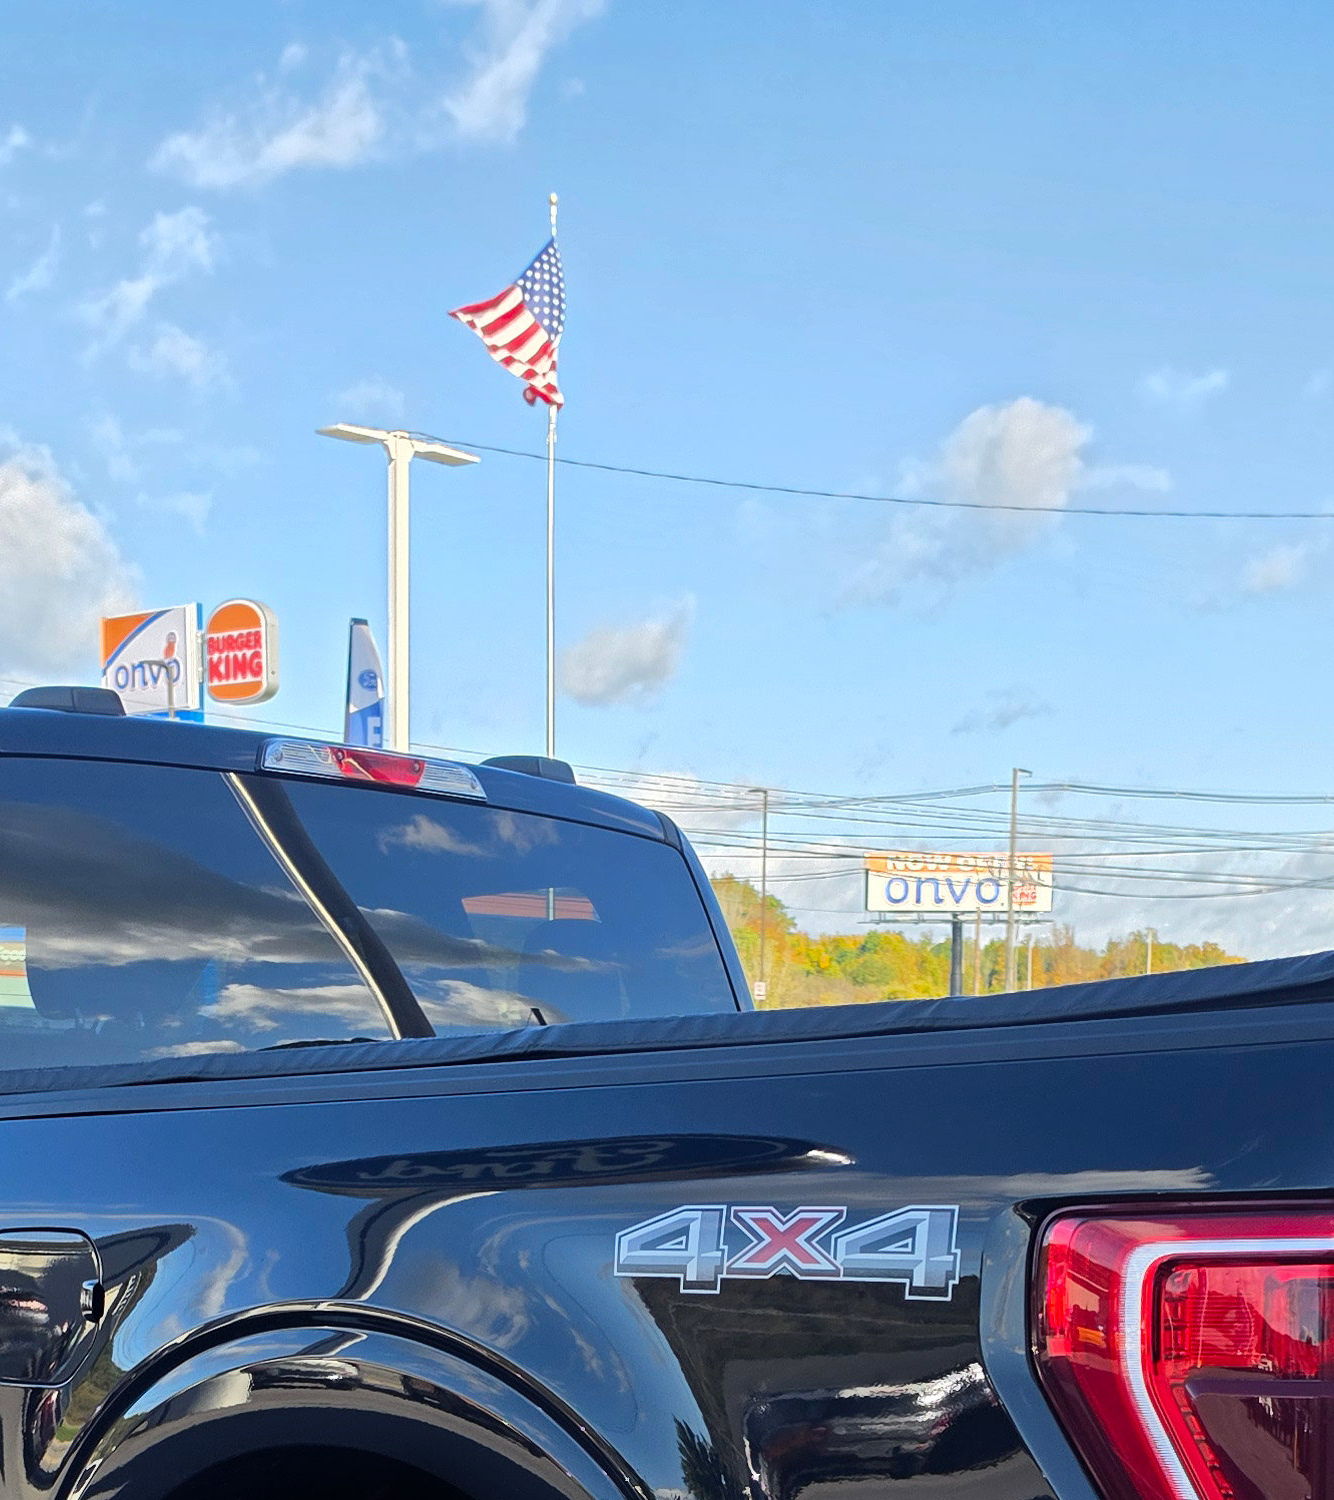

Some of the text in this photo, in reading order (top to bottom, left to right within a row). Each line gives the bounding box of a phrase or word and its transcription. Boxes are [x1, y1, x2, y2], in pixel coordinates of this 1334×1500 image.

[207, 630, 262, 653] BURGER
[114, 659, 181, 691] onvo
[208, 650, 263, 681] KING
[885, 877, 1000, 904] onvo
[613, 1204, 960, 1301] 4X4
